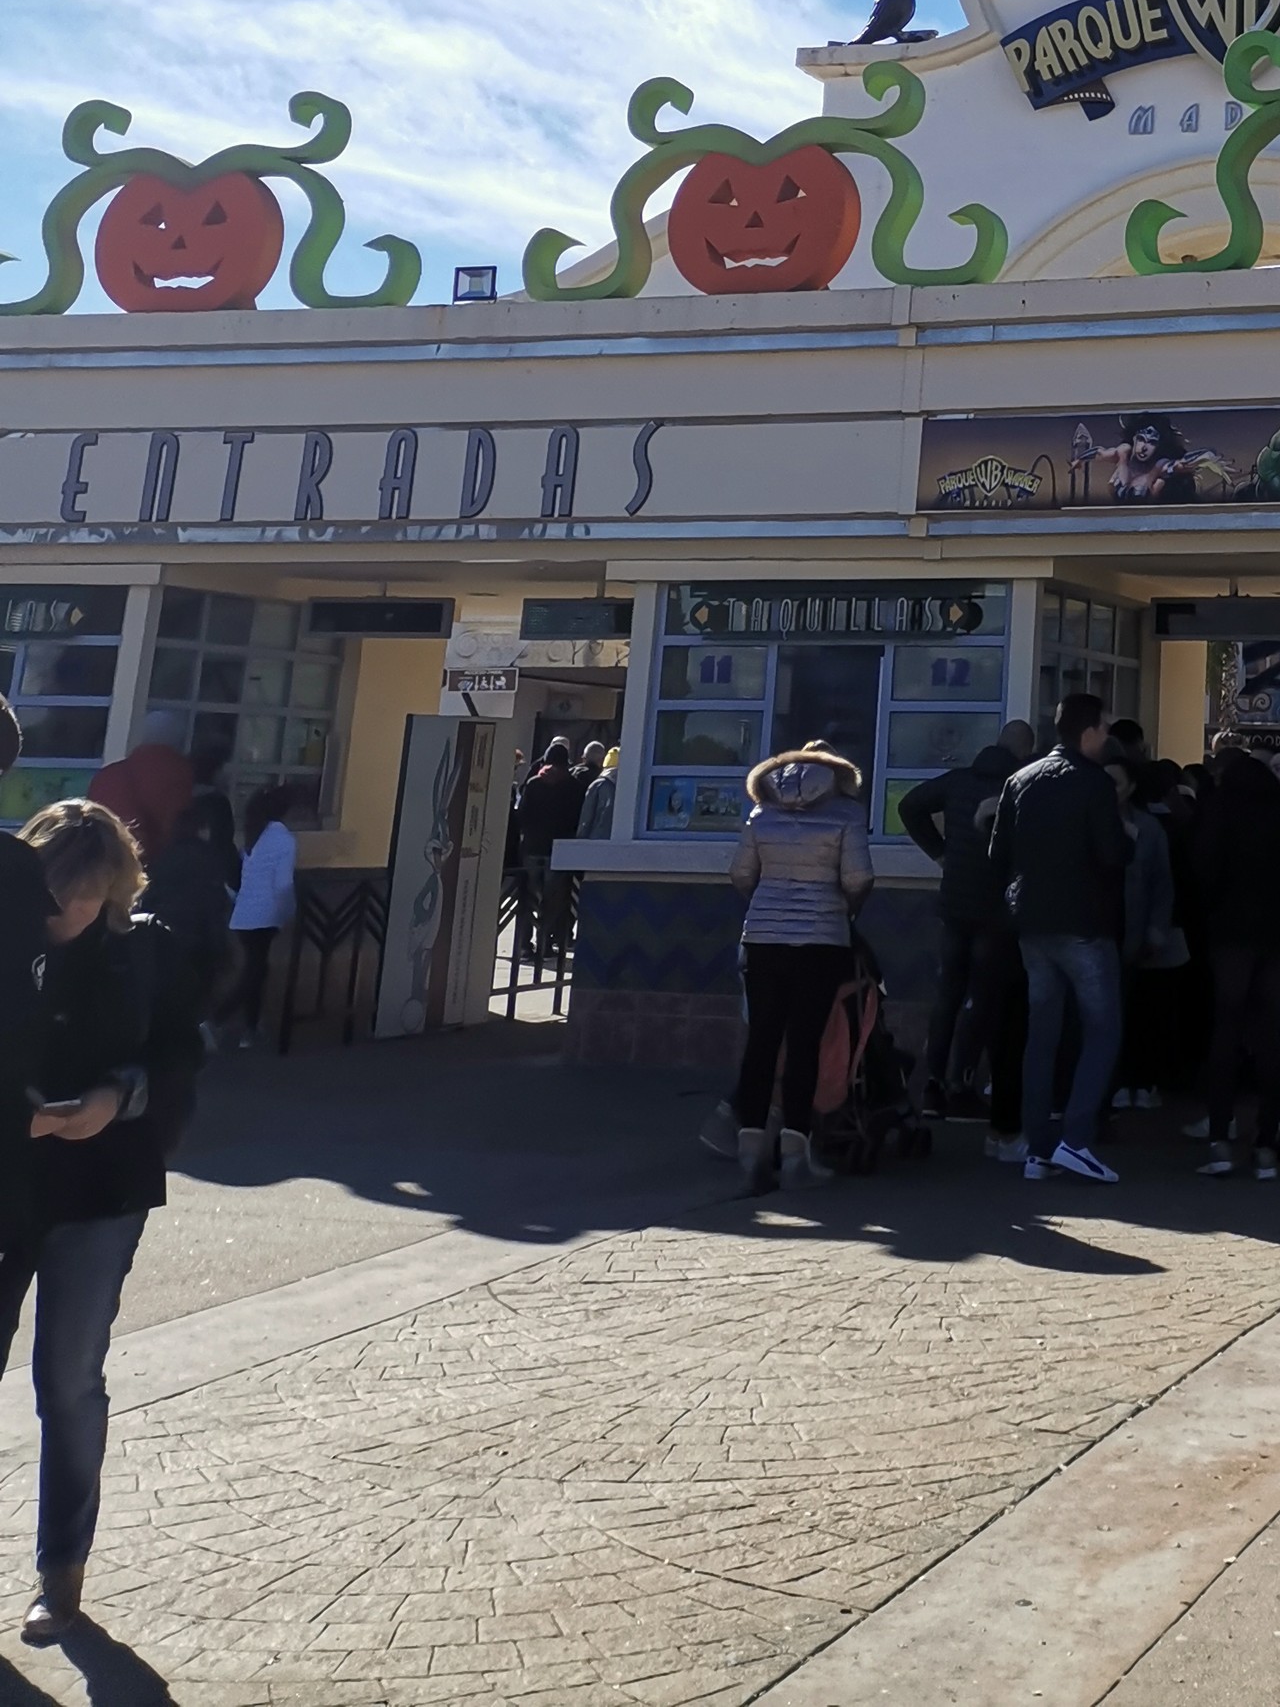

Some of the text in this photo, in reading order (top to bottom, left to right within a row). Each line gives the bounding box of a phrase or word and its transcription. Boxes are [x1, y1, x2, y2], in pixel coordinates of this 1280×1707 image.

[1129, 102, 1243, 135] MAD
[60, 421, 664, 522] ENTRADAS
[939, 471, 976, 494] PARQUE
[977, 460, 1002, 491] WB
[727, 596, 933, 641] TAQUILLAS
[700, 655, 732, 683] 11
[931, 658, 970, 686] 12
